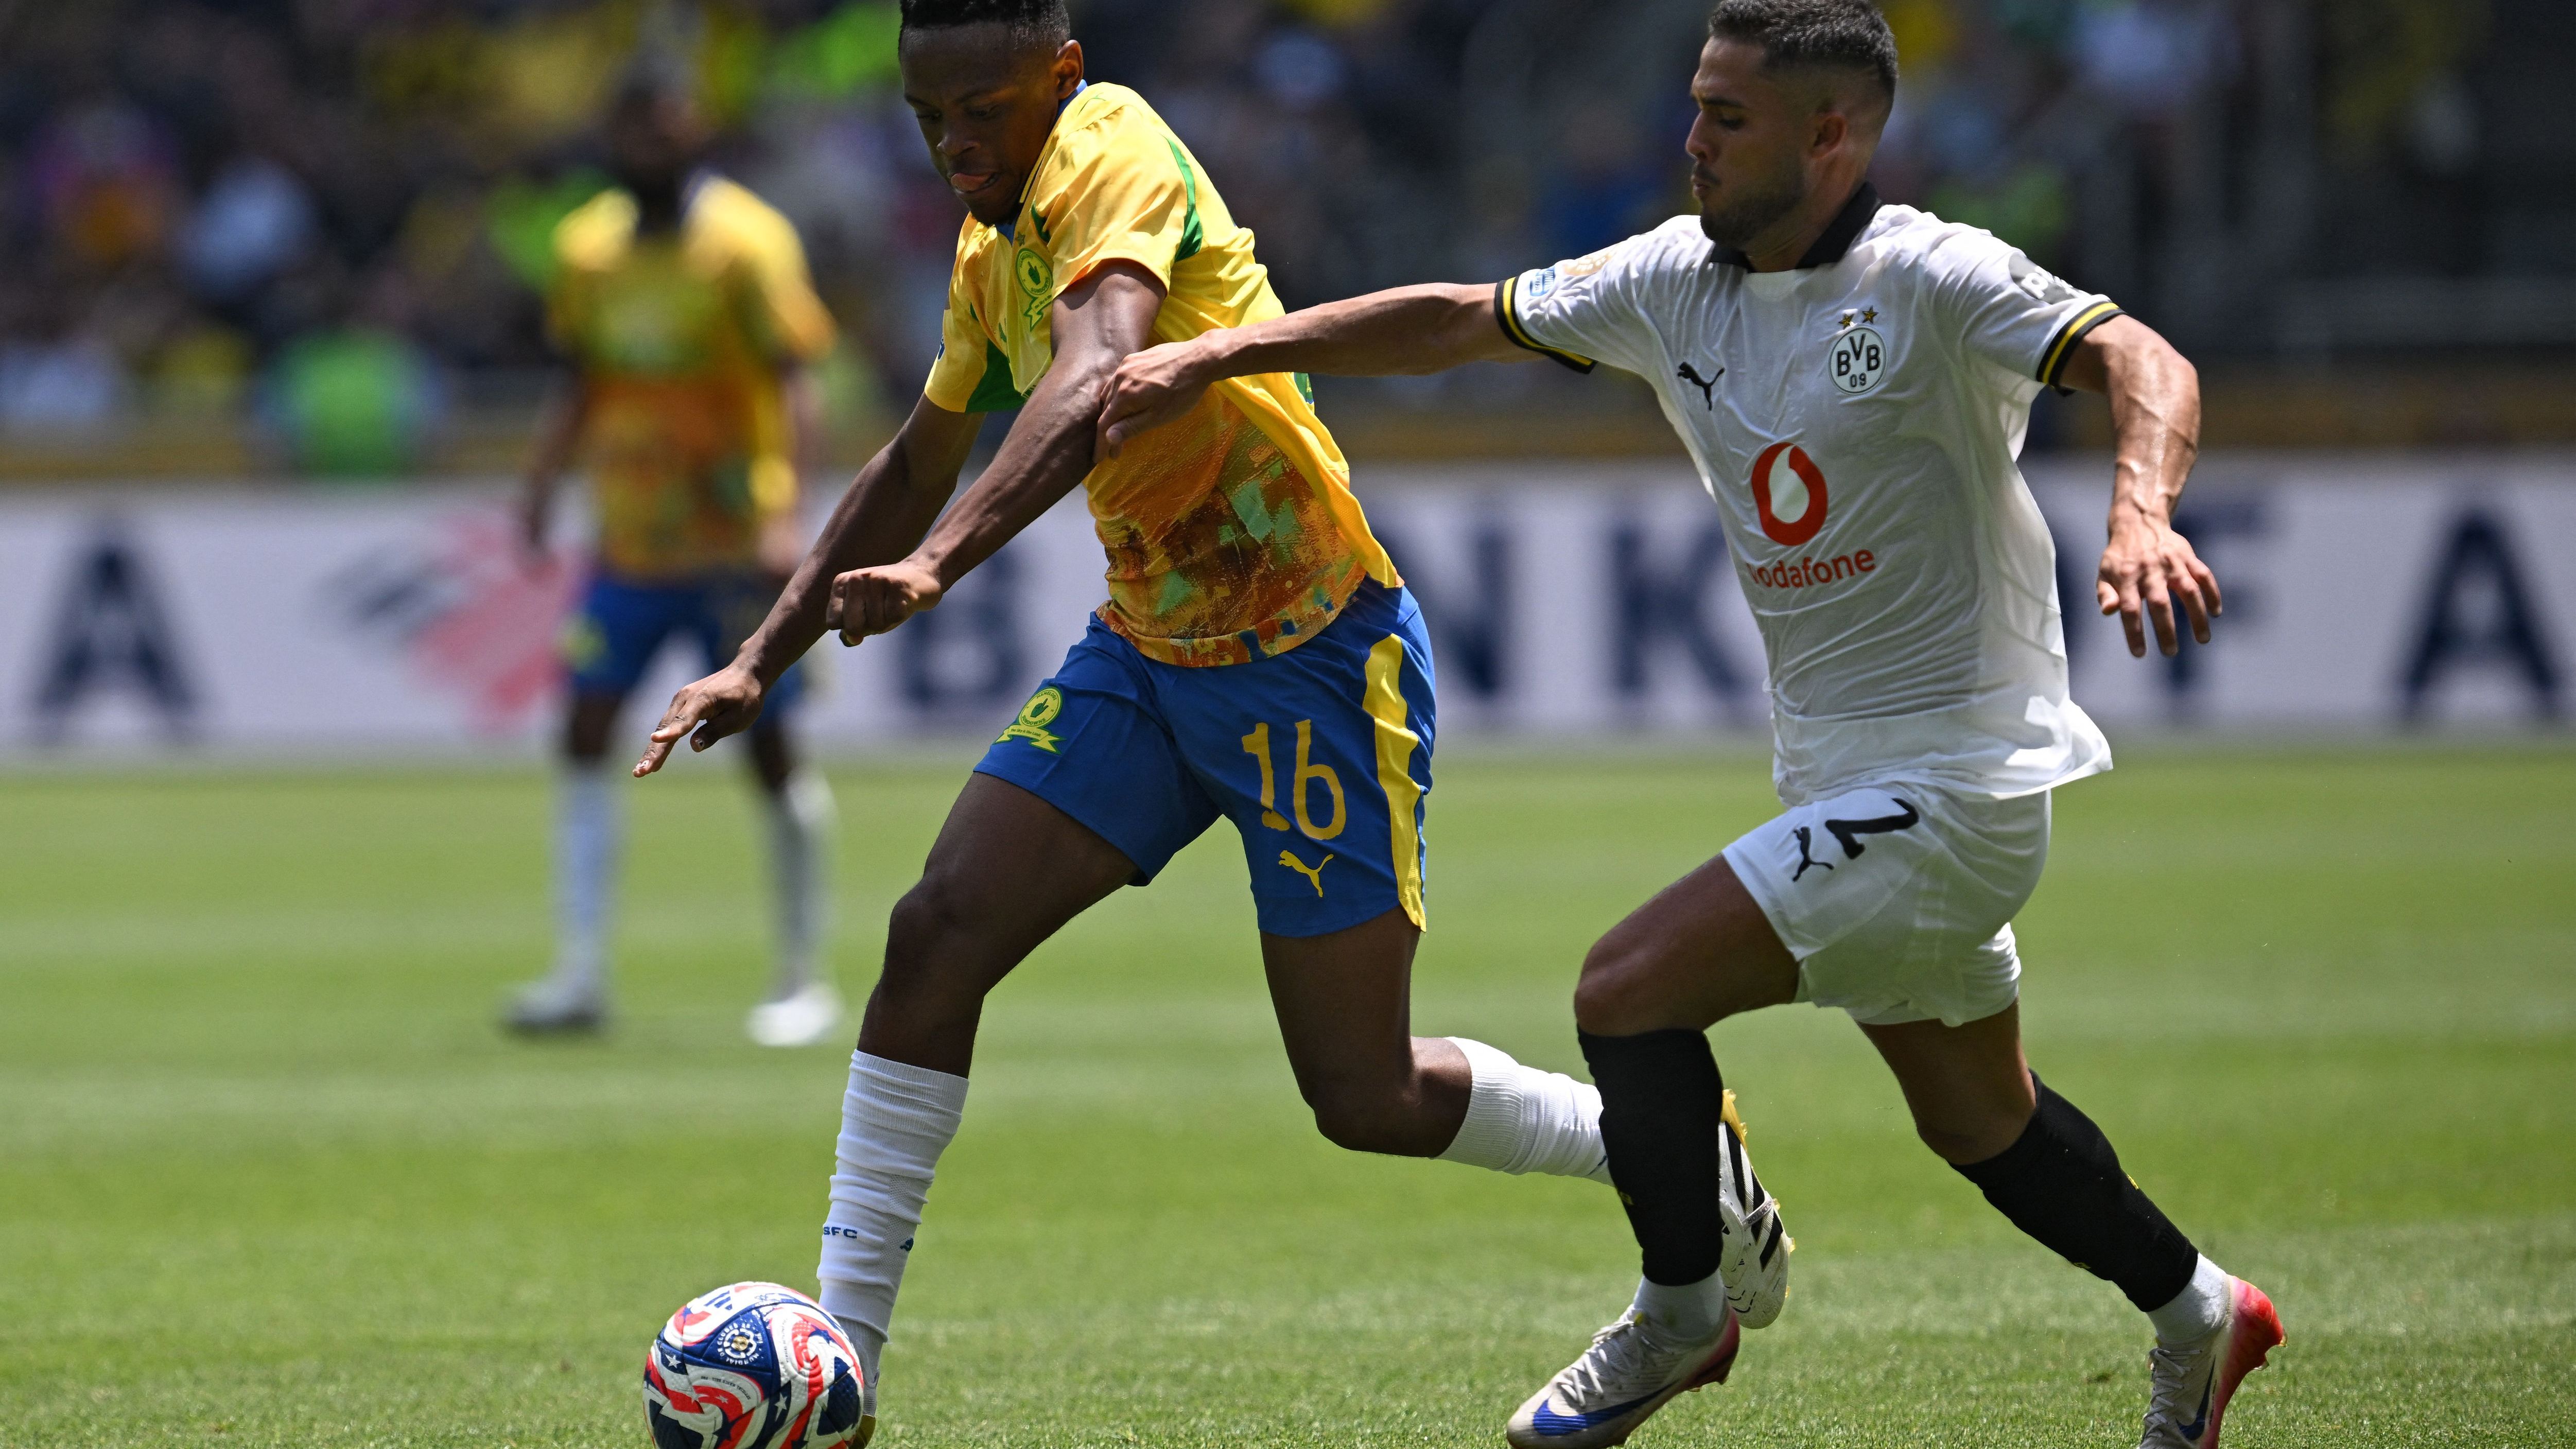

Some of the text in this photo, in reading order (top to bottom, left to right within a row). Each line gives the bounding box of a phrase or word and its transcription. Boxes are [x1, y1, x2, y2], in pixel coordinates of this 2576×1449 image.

[1837, 333, 1881, 377] BVB
[1850, 372, 1867, 388] 09
[1022, 715, 1046, 725] SUNDOWNS
[1241, 719, 1347, 841] 16
[1824, 797, 1920, 859] 2
[1747, 1200, 1772, 1224] EDATOR
[726, 1353, 759, 1365] MUNDIAL
